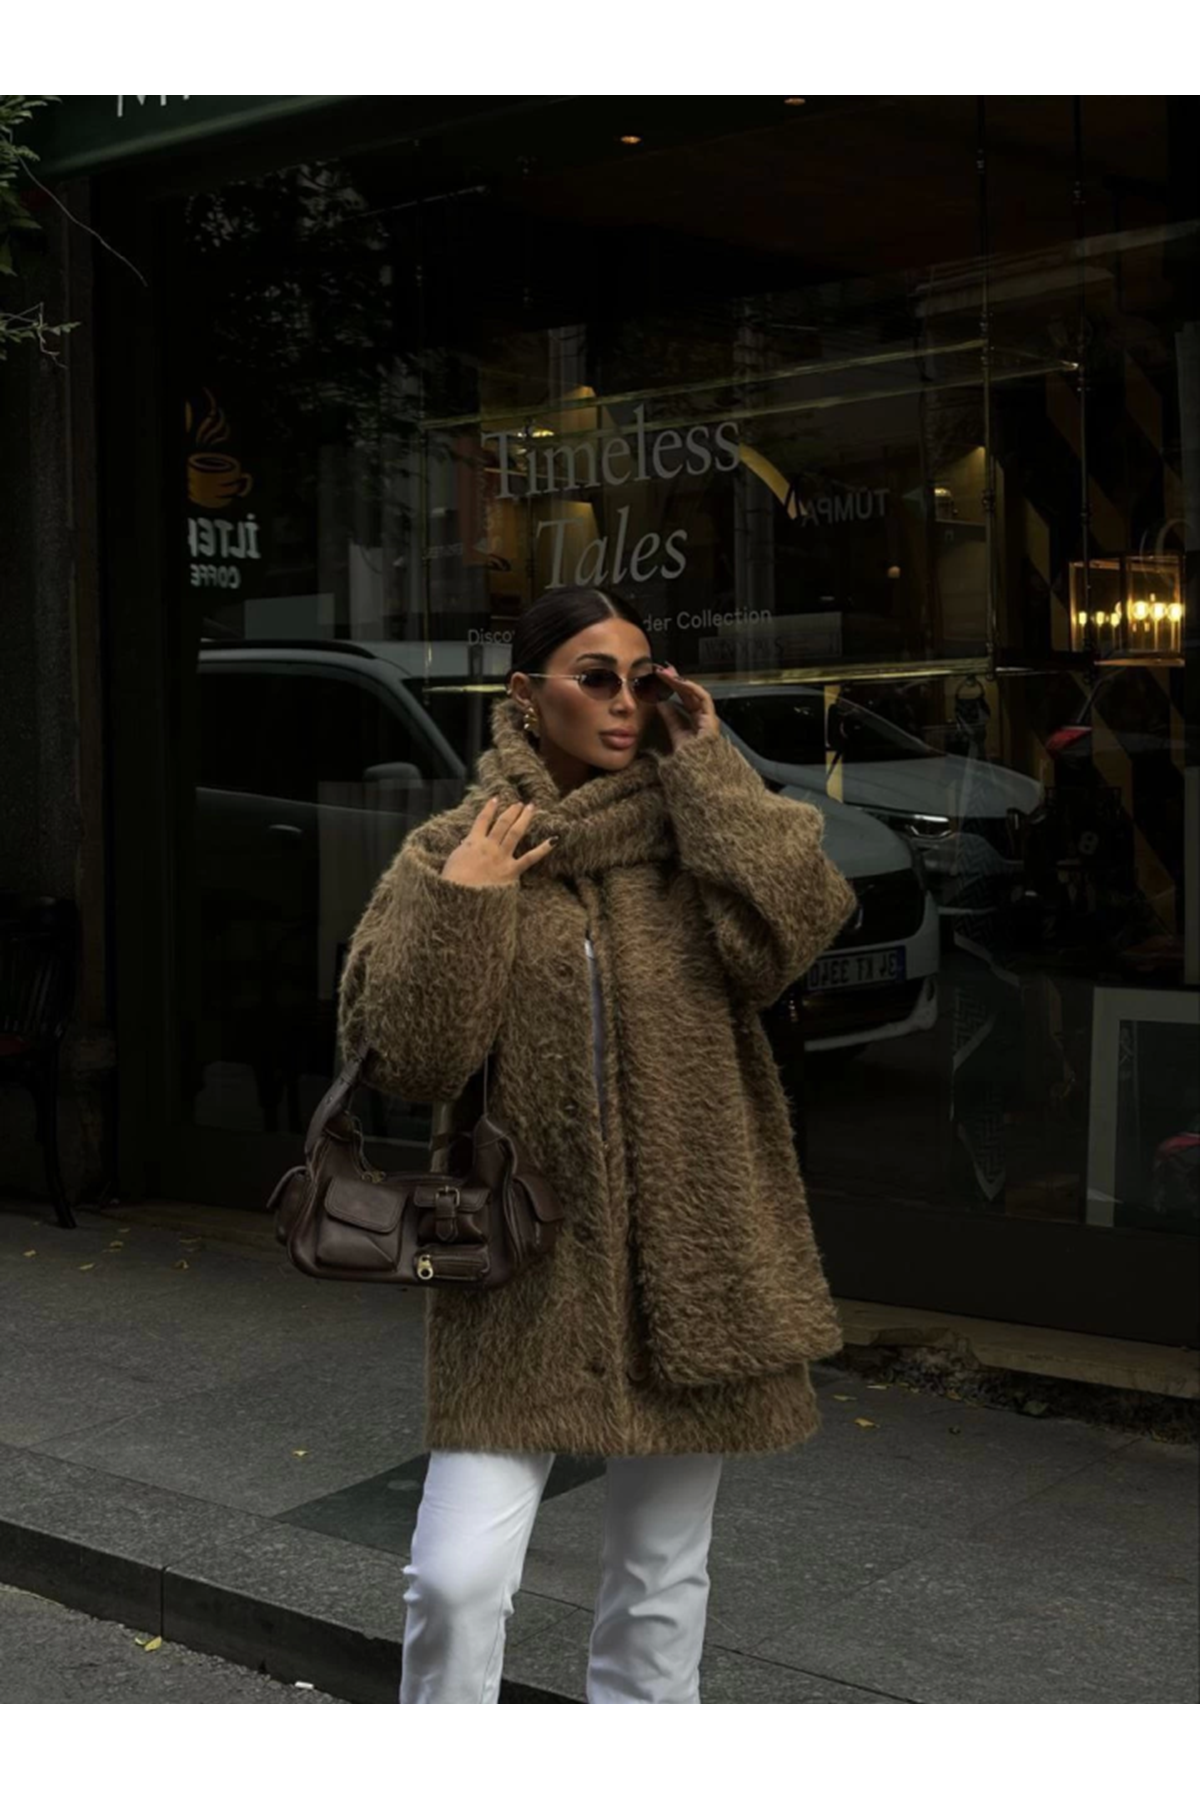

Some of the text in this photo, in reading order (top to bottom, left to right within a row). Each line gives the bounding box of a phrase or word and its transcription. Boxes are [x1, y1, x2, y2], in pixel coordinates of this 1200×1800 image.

[480, 403, 742, 499] Timeless
[536, 504, 688, 590] Tales
[467, 628, 516, 645] Disco
[676, 606, 773, 631] Collection
